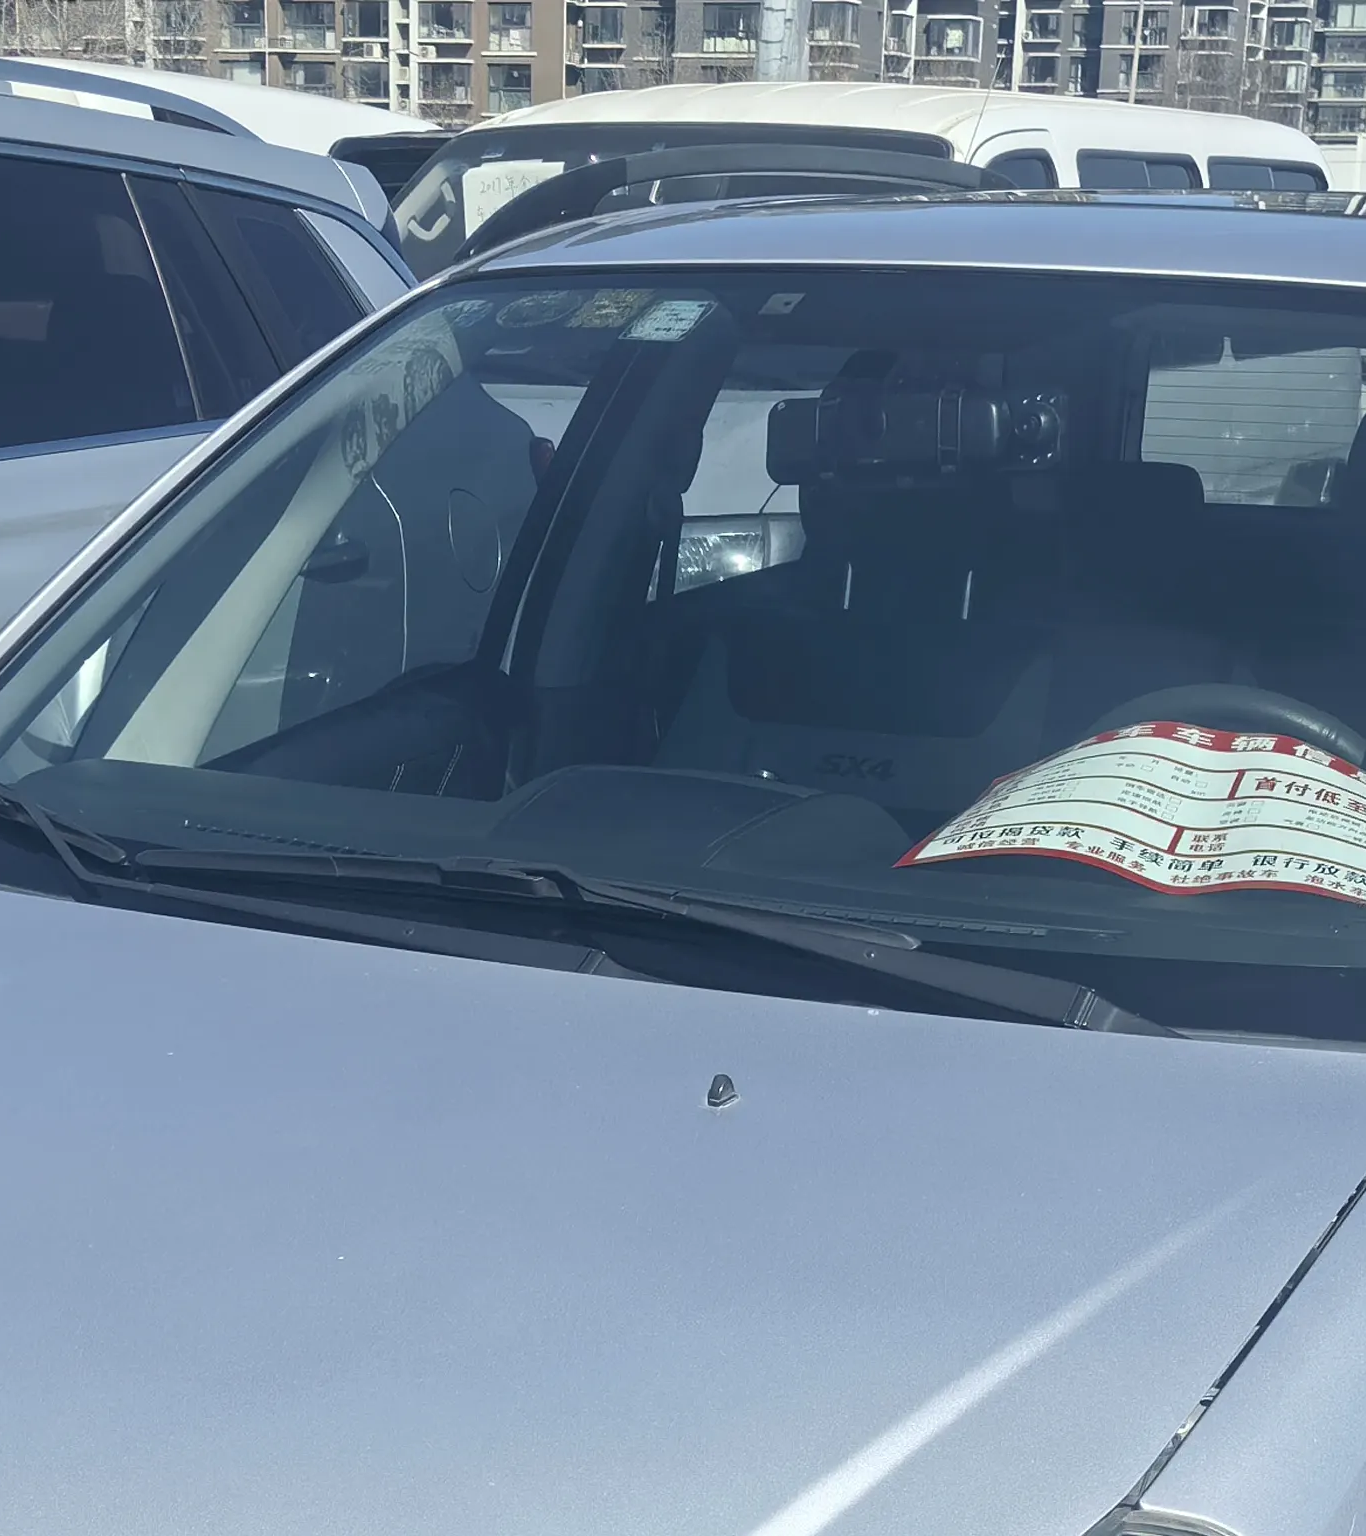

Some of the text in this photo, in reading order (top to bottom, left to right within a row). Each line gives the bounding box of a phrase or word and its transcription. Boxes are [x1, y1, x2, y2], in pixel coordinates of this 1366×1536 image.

[1064, 840, 1147, 872] 专业服务
[1109, 836, 1224, 873] 手续简单
